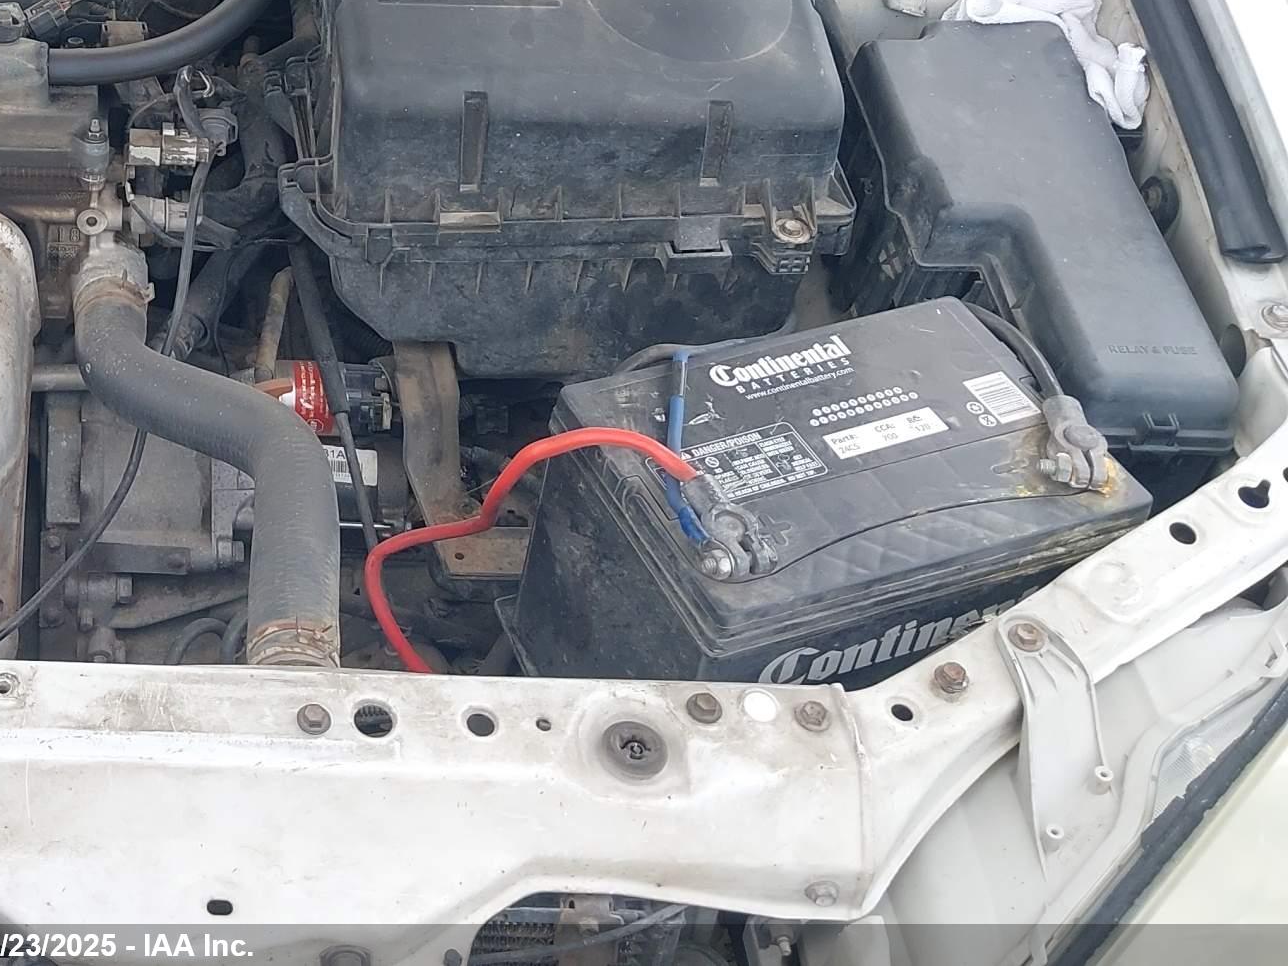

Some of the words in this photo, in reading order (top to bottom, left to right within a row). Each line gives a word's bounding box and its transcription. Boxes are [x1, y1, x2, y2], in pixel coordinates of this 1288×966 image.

[709, 334, 851, 386] Continental
[736, 357, 850, 394] BATTERIES
[745, 367, 855, 400] www.continentalbattery.com
